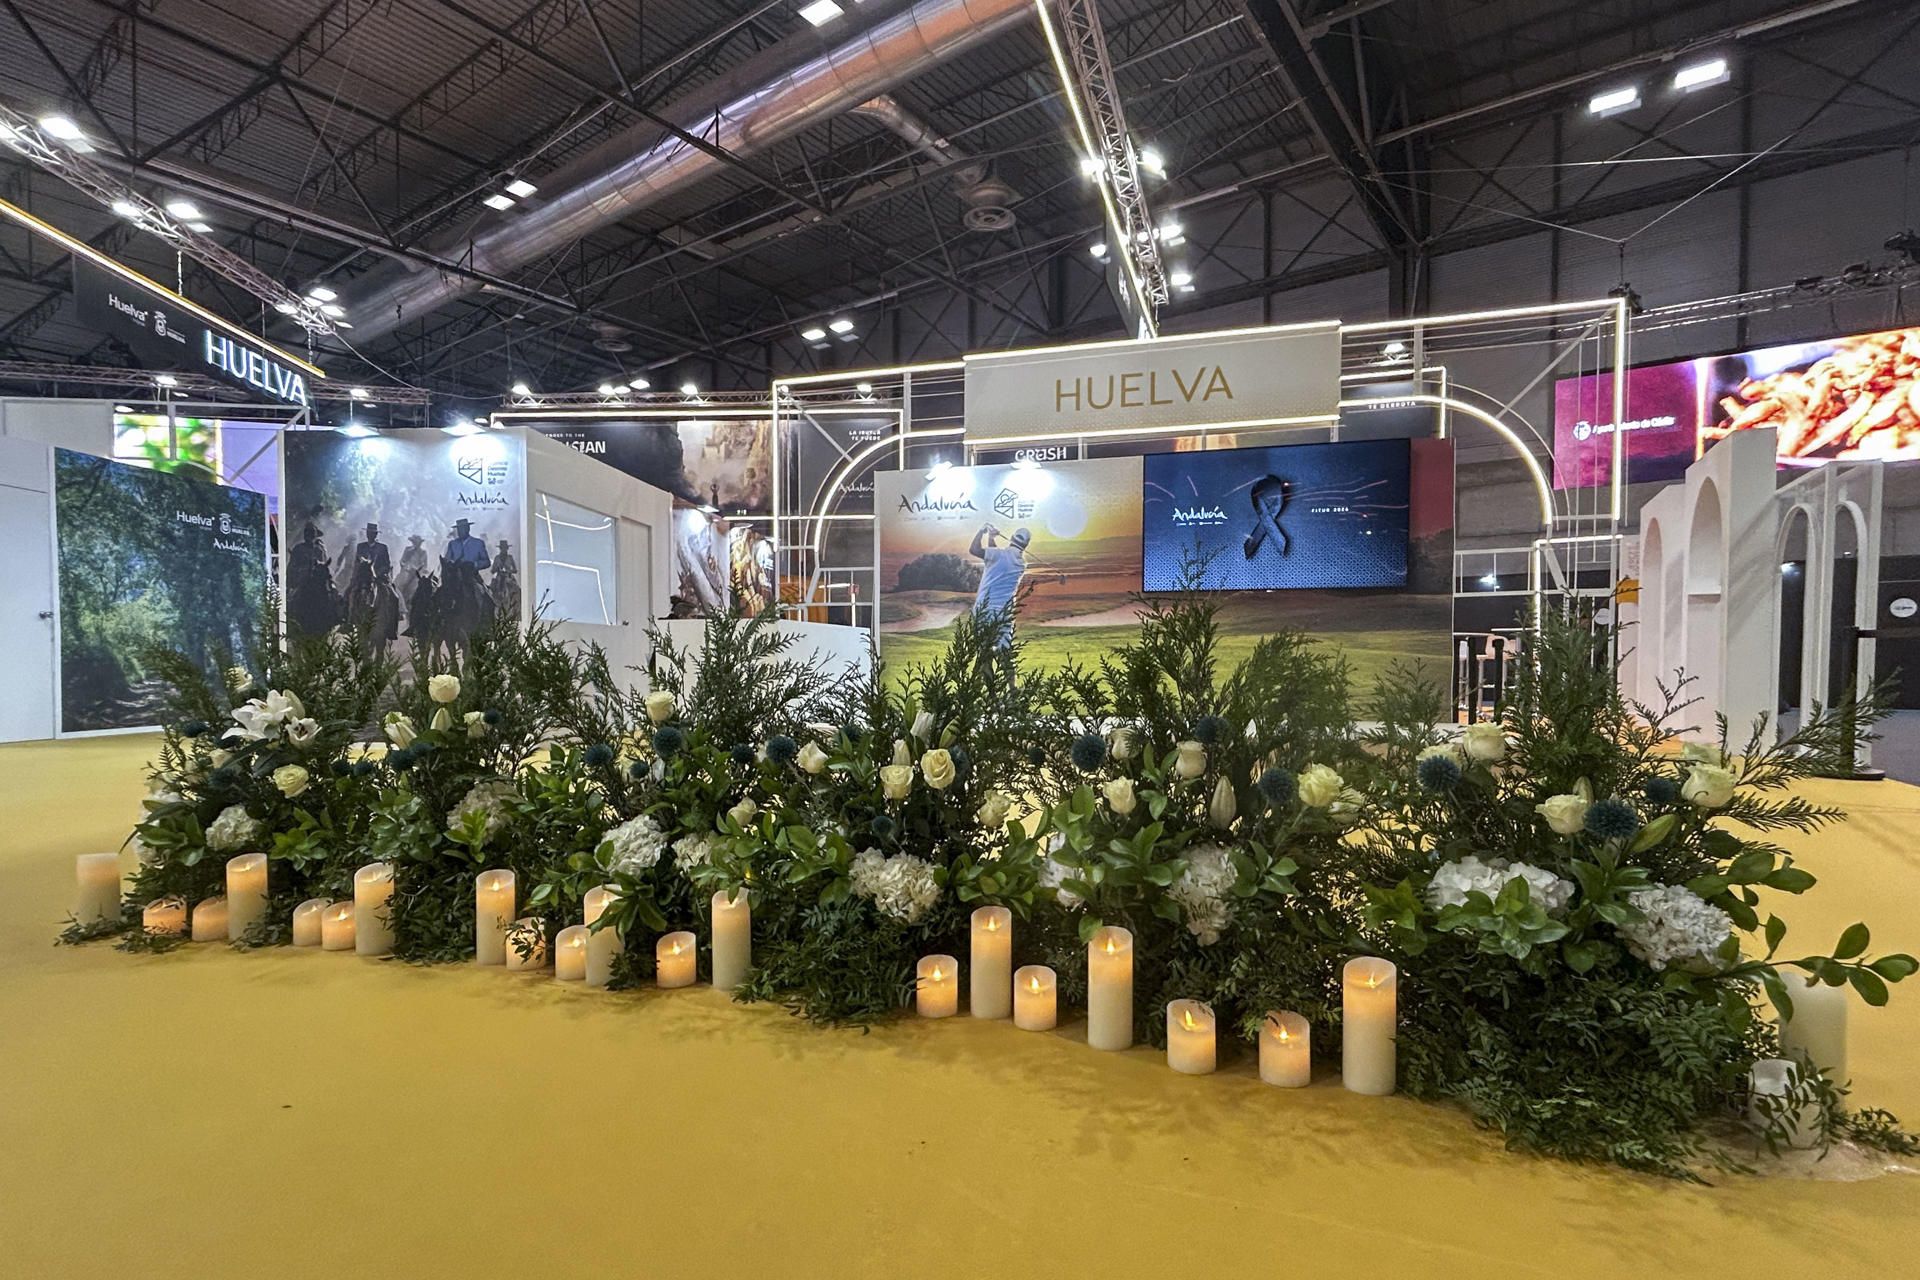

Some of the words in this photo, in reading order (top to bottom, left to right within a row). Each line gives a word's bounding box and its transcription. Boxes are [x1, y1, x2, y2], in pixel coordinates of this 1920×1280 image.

[108, 293, 147, 321] Huelva
[205, 329, 308, 406] HUELVA
[1056, 366, 1233, 413] HUELVA
[898, 493, 979, 514] Andalucía
[1172, 506, 1228, 521] Andalucía
[176, 510, 214, 527] Huelva
